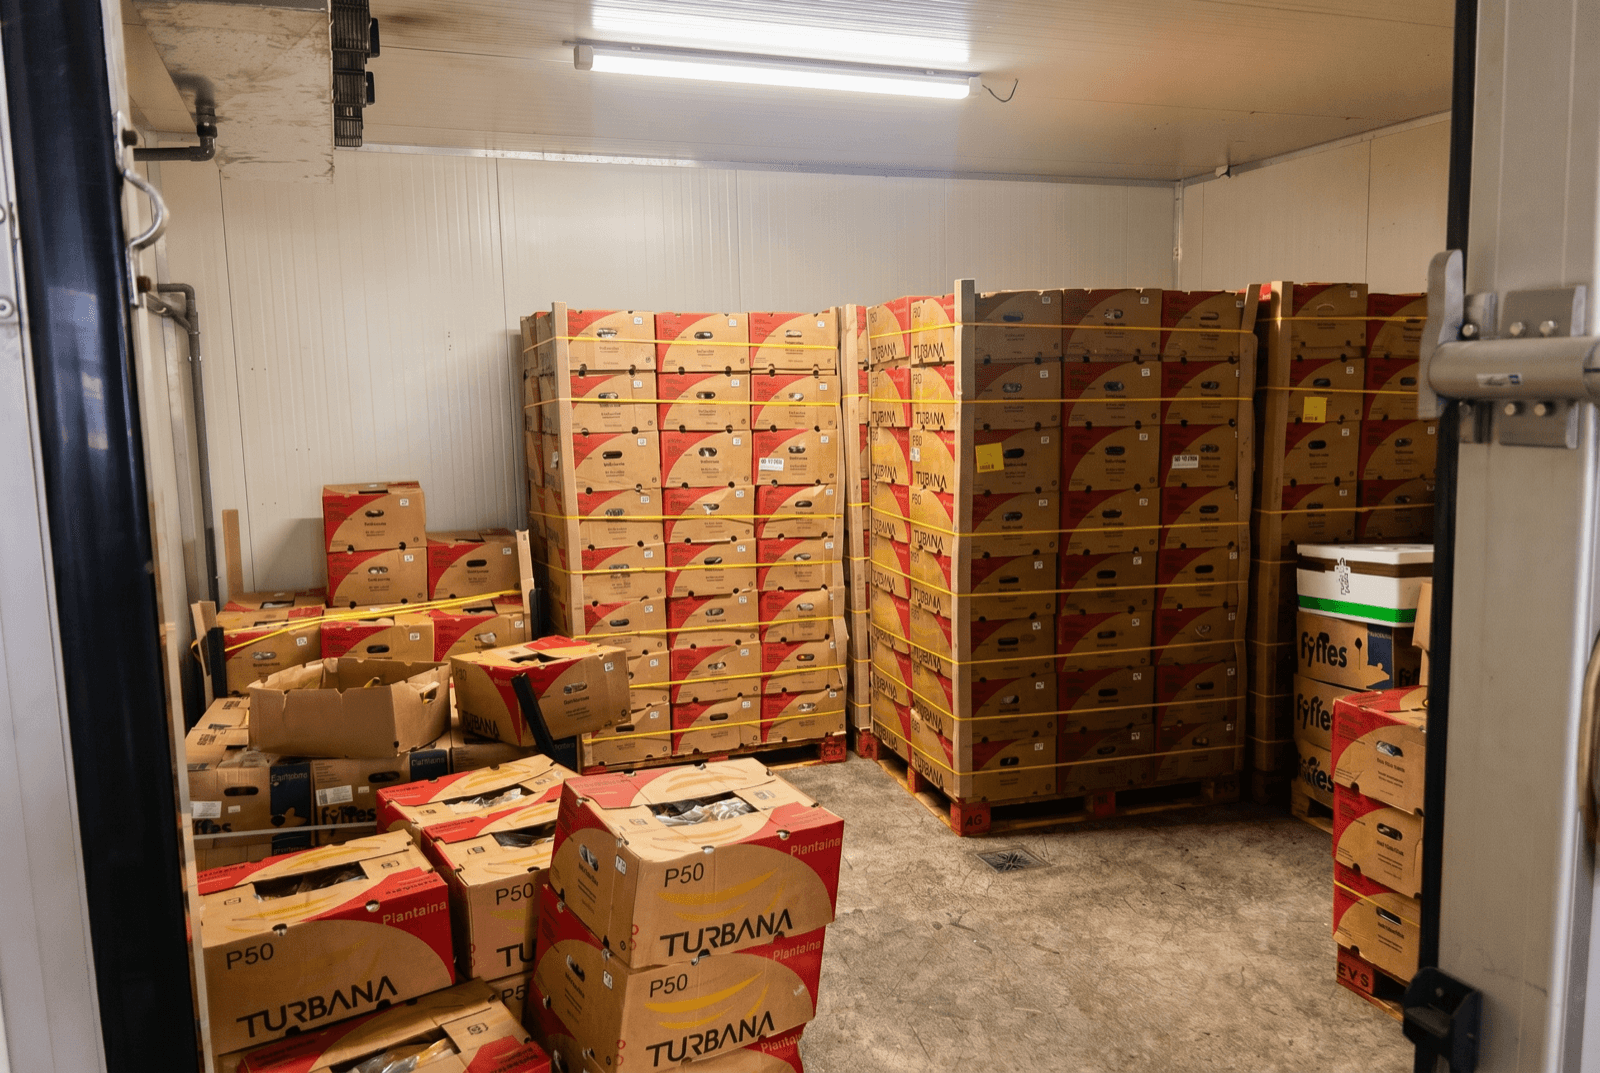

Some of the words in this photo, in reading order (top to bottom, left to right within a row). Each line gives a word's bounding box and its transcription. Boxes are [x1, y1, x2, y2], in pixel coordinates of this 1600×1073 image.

[1297, 693, 1333, 731] fyffe
[965, 814, 982, 827] AG
[664, 862, 704, 888] P50
[496, 882, 534, 906] P50
[659, 908, 793, 957] TURBANA
[226, 942, 274, 970] P50
[501, 983, 530, 1004] P5
[650, 973, 688, 998] P50
[236, 975, 398, 1038] TURBANA
[645, 1010, 775, 1068] TURBANA
